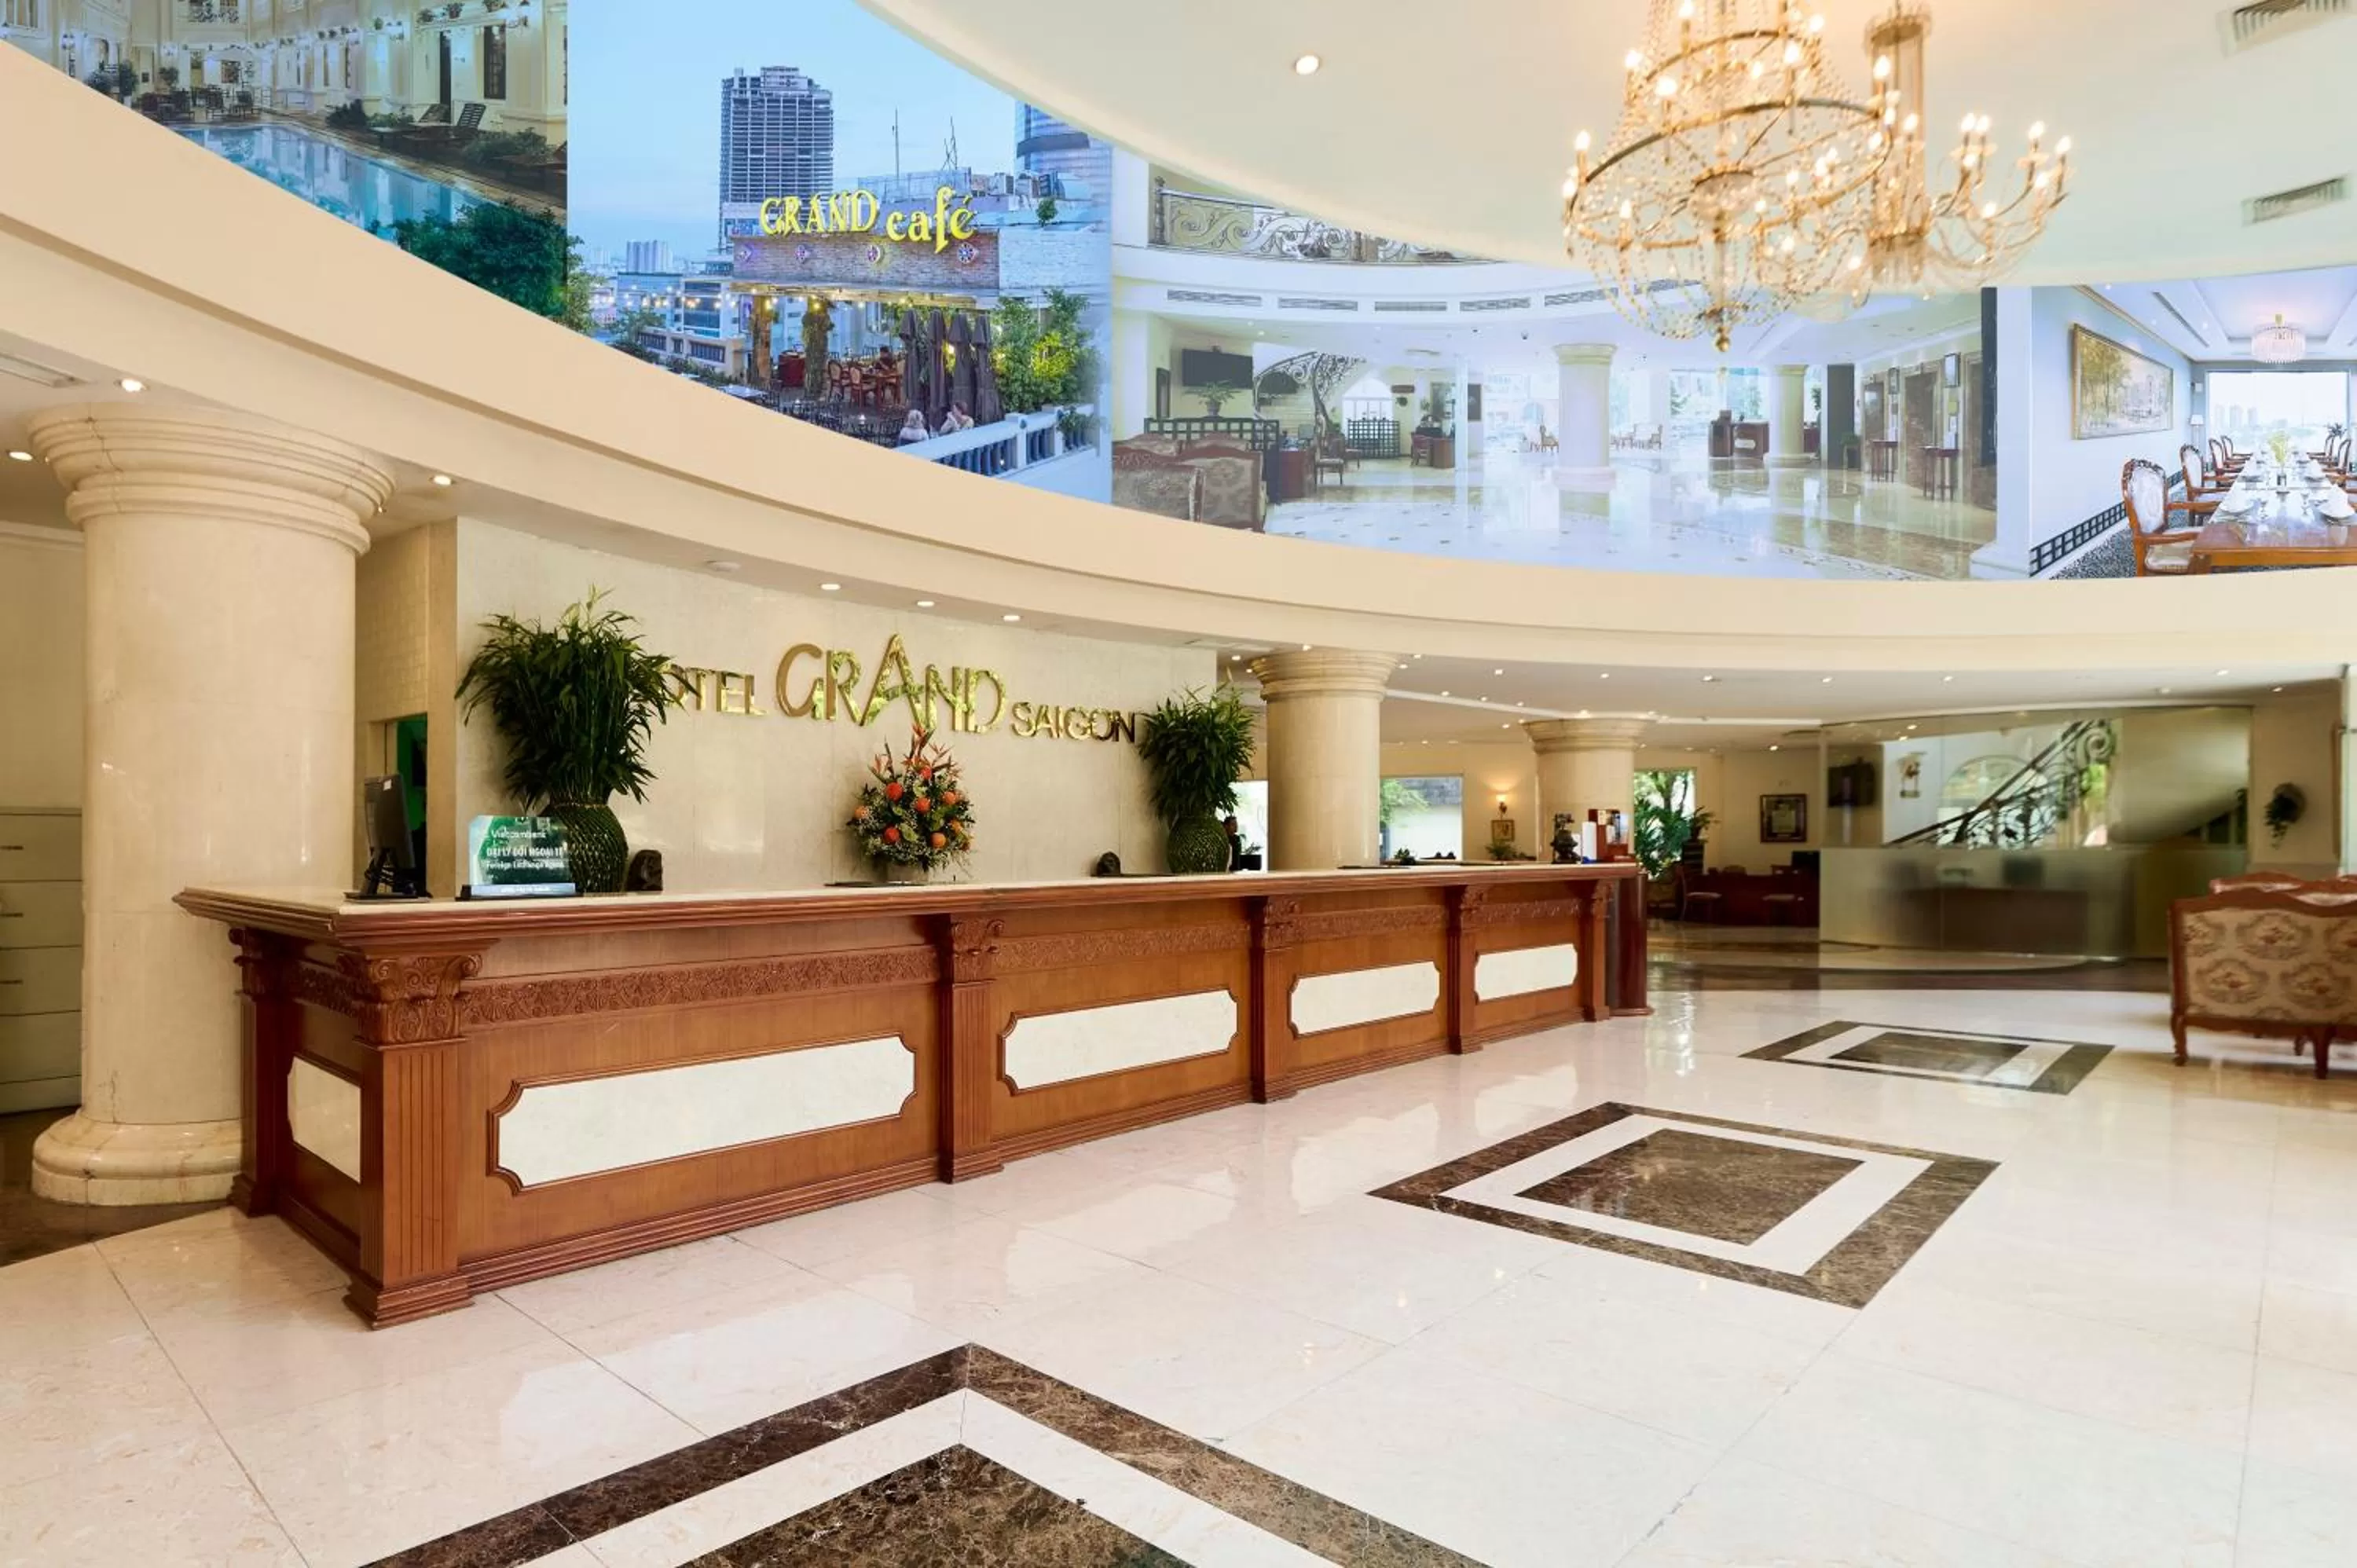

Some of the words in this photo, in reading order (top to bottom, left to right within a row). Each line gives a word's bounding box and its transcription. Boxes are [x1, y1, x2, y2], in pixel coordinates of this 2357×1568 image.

[760, 189, 880, 236] GRAND
[886, 185, 976, 254] café
[657, 663, 768, 716] OTEL
[775, 633, 1006, 733] GRAND
[1012, 702, 1135, 742] SAIGON
